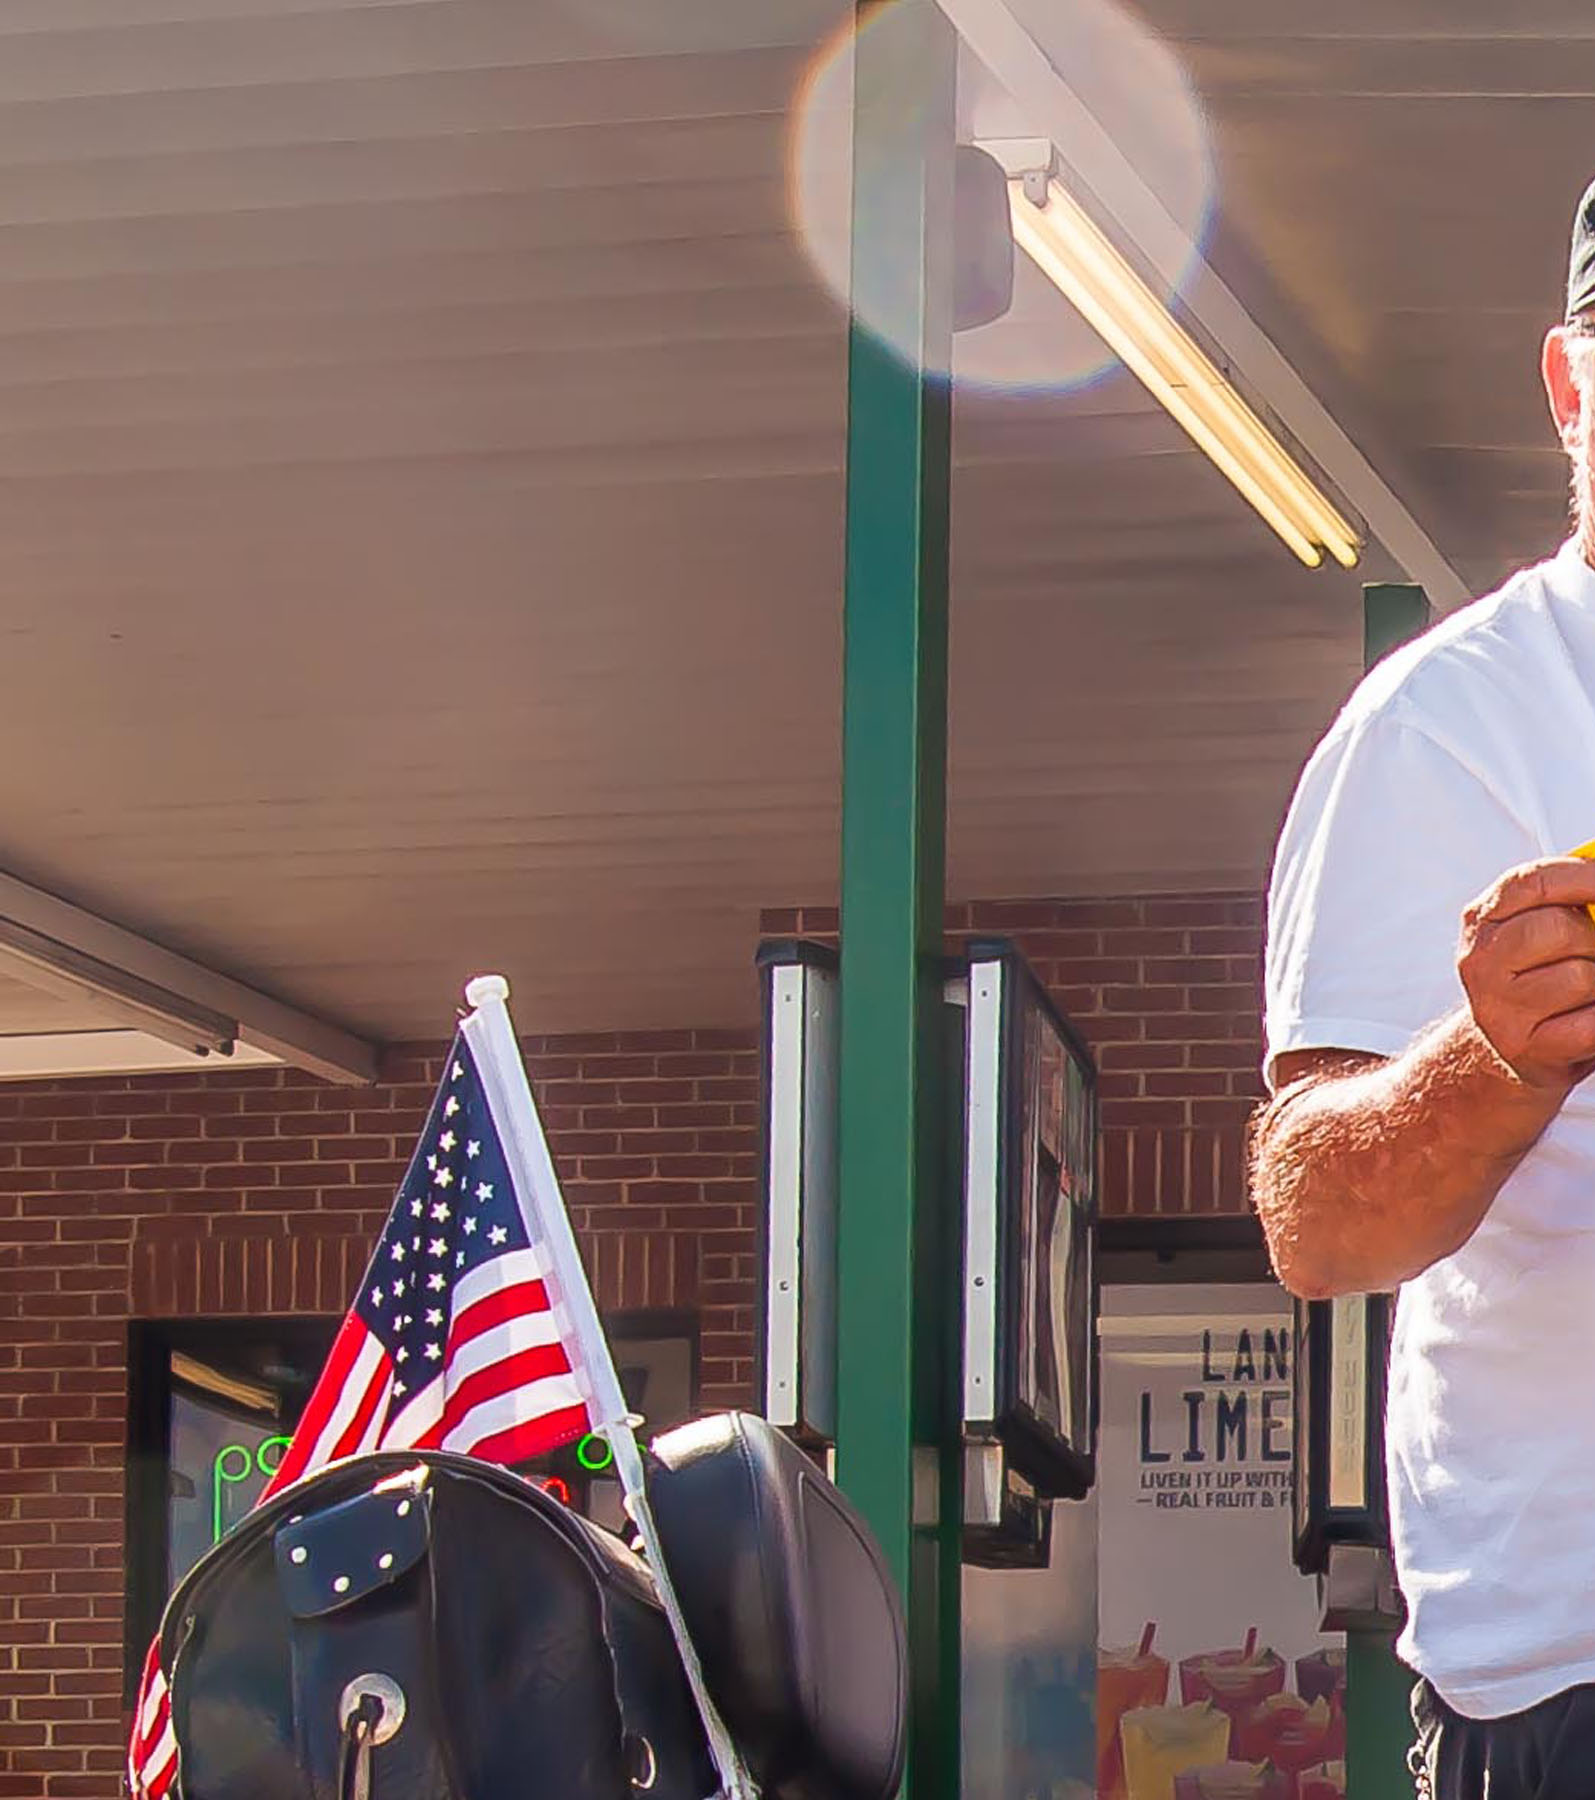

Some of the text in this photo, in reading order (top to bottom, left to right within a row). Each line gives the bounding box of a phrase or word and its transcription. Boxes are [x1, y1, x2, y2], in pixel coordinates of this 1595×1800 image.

[1141, 1472, 1191, 1489] LIVEN
[1197, 1472, 1213, 1489] IT
[1217, 1472, 1241, 1489] UP
[1157, 1492, 1199, 1508] REAL
[1206, 1492, 1257, 1508] FRUIT
